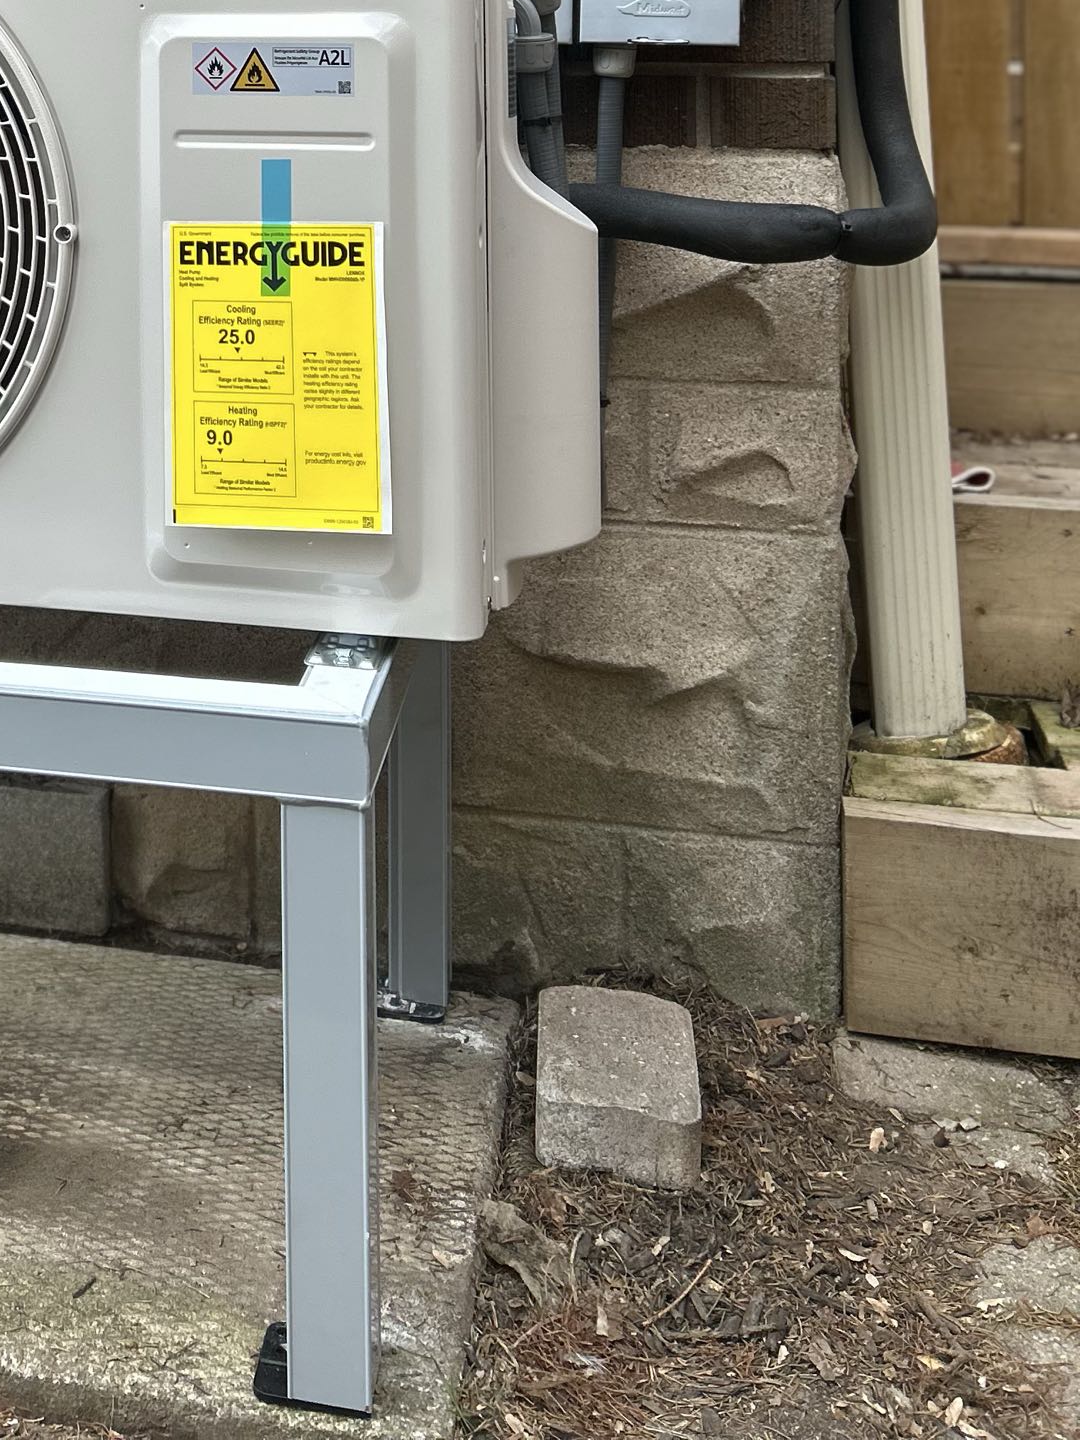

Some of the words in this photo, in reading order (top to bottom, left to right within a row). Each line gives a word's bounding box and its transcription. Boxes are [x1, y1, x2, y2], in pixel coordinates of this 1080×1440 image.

[319, 50, 350, 66] A2L
[180, 241, 365, 267] ENERGYGUIDE
[226, 305, 256, 315] Cooling
[199, 316, 235, 326] Efficiency
[237, 317, 261, 327] Rating
[218, 329, 255, 344] 25.0
[228, 406, 258, 416] Heating
[200, 416, 236, 427] Efficiency
[238, 418, 263, 429] Rating
[206, 429, 233, 445] 9.0
